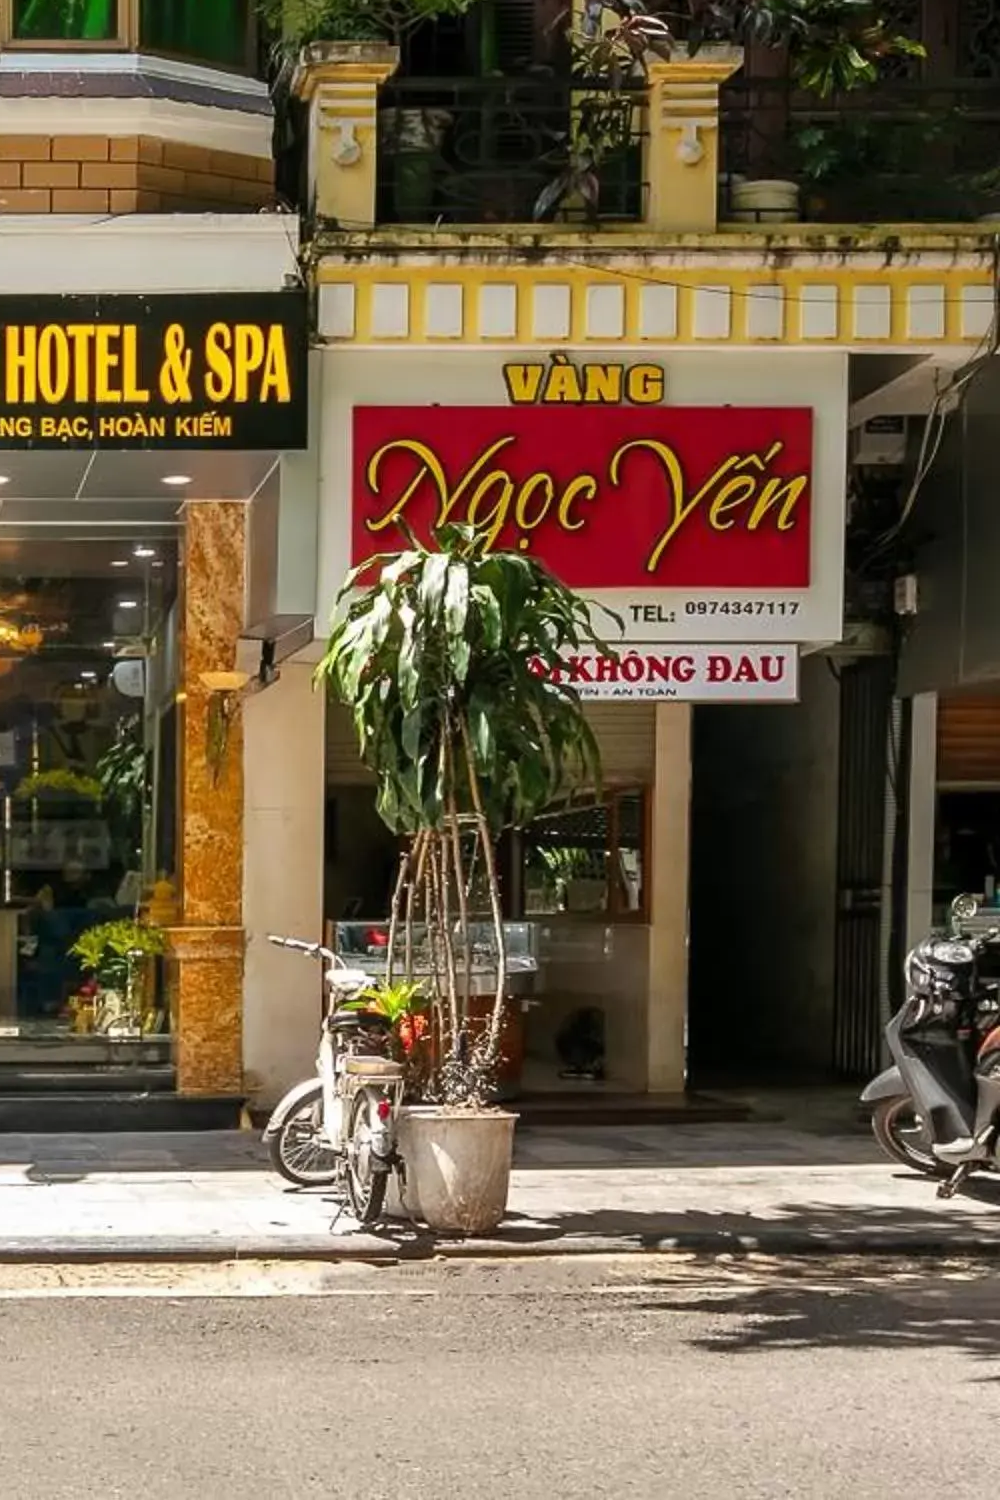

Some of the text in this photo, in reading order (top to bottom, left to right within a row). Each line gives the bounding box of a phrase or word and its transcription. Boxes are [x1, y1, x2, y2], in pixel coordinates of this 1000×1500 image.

[5, 323, 149, 404] HOTEL
[160, 323, 192, 404] &
[205, 322, 291, 404] SPA
[503, 354, 665, 405] VÀNG
[41, 415, 94, 443] BẠC,
[100, 410, 166, 437] HOÀN
[175, 409, 232, 437] KIẾM
[365, 435, 808, 573] Ngọc Yến
[629, 601, 800, 623] TEL: 0974347117
[568, 650, 697, 683] KHÔNG
[706, 656, 786, 683] ĐAU
